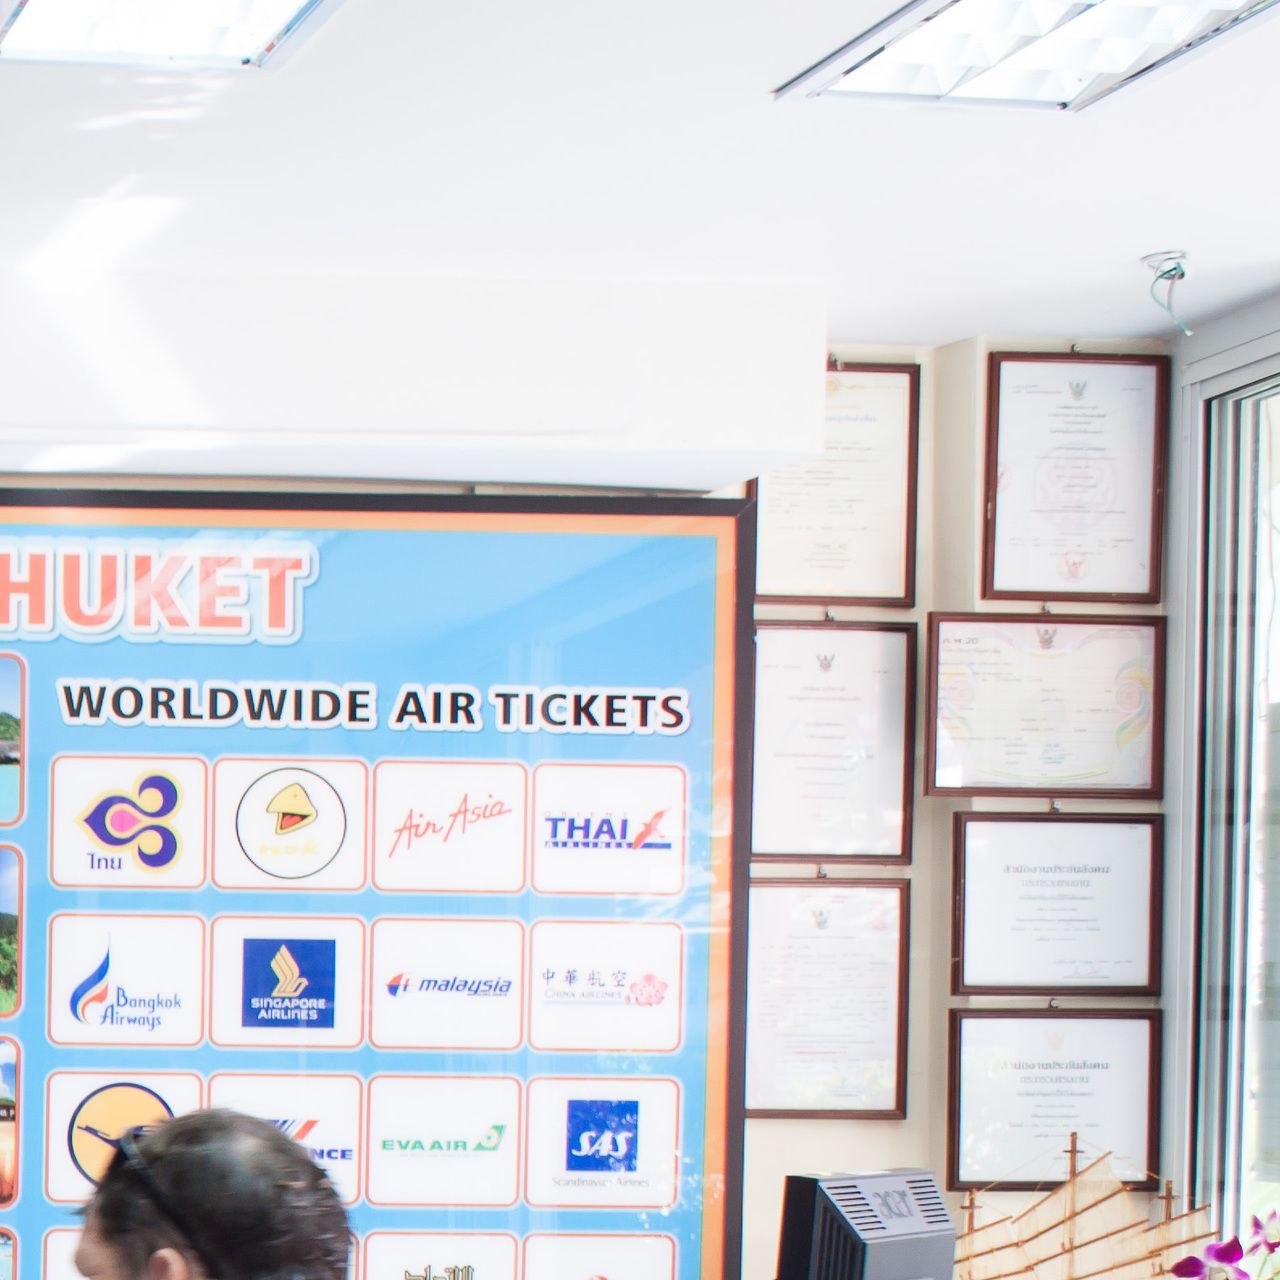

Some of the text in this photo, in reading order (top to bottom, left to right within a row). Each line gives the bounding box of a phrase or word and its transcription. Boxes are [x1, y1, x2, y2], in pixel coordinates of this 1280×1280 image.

[62, 684, 685, 729] WORLDWIDE AIR TICKETS
[388, 792, 513, 859] Air Asia
[544, 817, 629, 840] THAI
[86, 852, 123, 871] ไทย
[418, 976, 513, 997] malaysia
[116, 986, 182, 1016] Bangkok
[250, 997, 326, 1010] SINGAPORE
[99, 1004, 162, 1032] Airways
[257, 1009, 319, 1021] AIRLINES
[381, 1139, 468, 1151] EVA AIR
[570, 1129, 634, 1157] SAS
